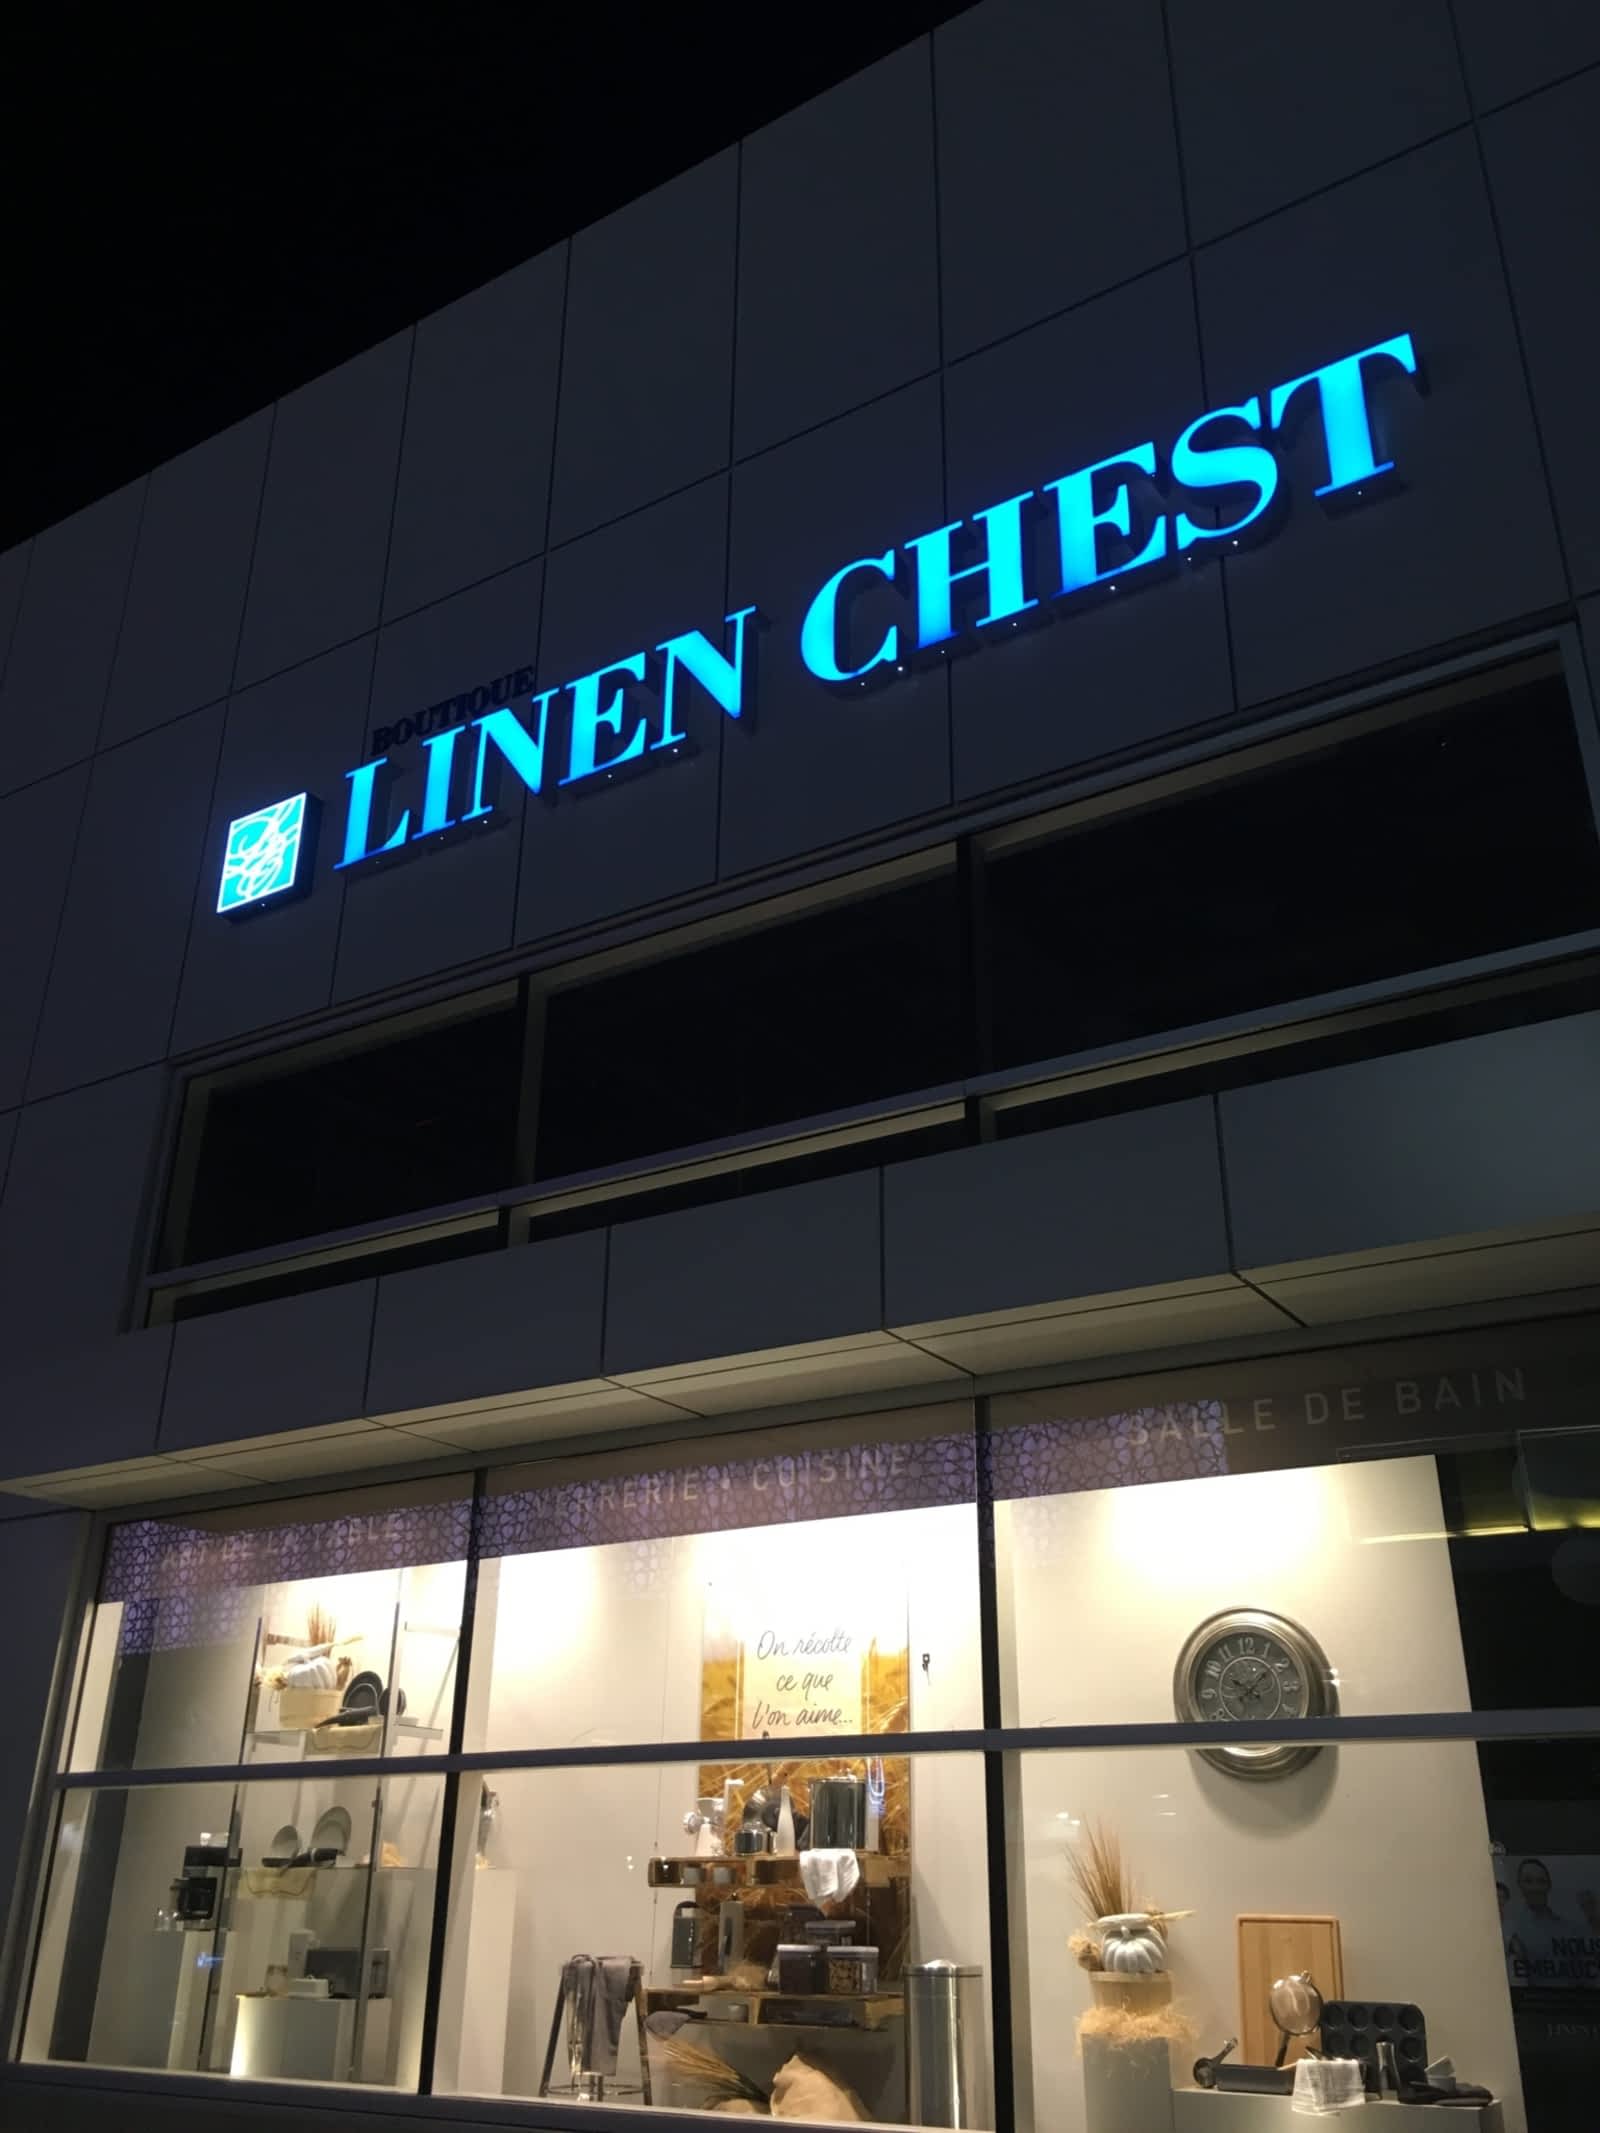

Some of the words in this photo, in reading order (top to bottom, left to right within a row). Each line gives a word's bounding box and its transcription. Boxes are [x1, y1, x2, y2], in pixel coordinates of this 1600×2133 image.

[333, 606, 756, 871] LINEN
[799, 331, 1418, 683] CHEST
[371, 666, 536, 757] BOUTIQUE
[1126, 1397, 1276, 1446] SALLE
[1304, 1387, 1365, 1426] DE
[1394, 1367, 1526, 1415] BAIN
[752, 1447, 908, 1492] CUISINE
[756, 1630, 788, 1660] On
[792, 1625, 852, 1656] récolte
[1217, 1643, 1234, 1662] 11
[1237, 1636, 1255, 1655] 12
[1261, 1641, 1271, 1659] 1
[1204, 1659, 1223, 1680] 10
[1274, 1657, 1291, 1673] 2
[776, 1674, 797, 1692] ce
[802, 1671, 834, 1702] que
[1201, 1687, 1218, 1700] 9
[752, 1699, 790, 1730] l'on
[1514, 1959, 1600, 1980] EMBAUC
